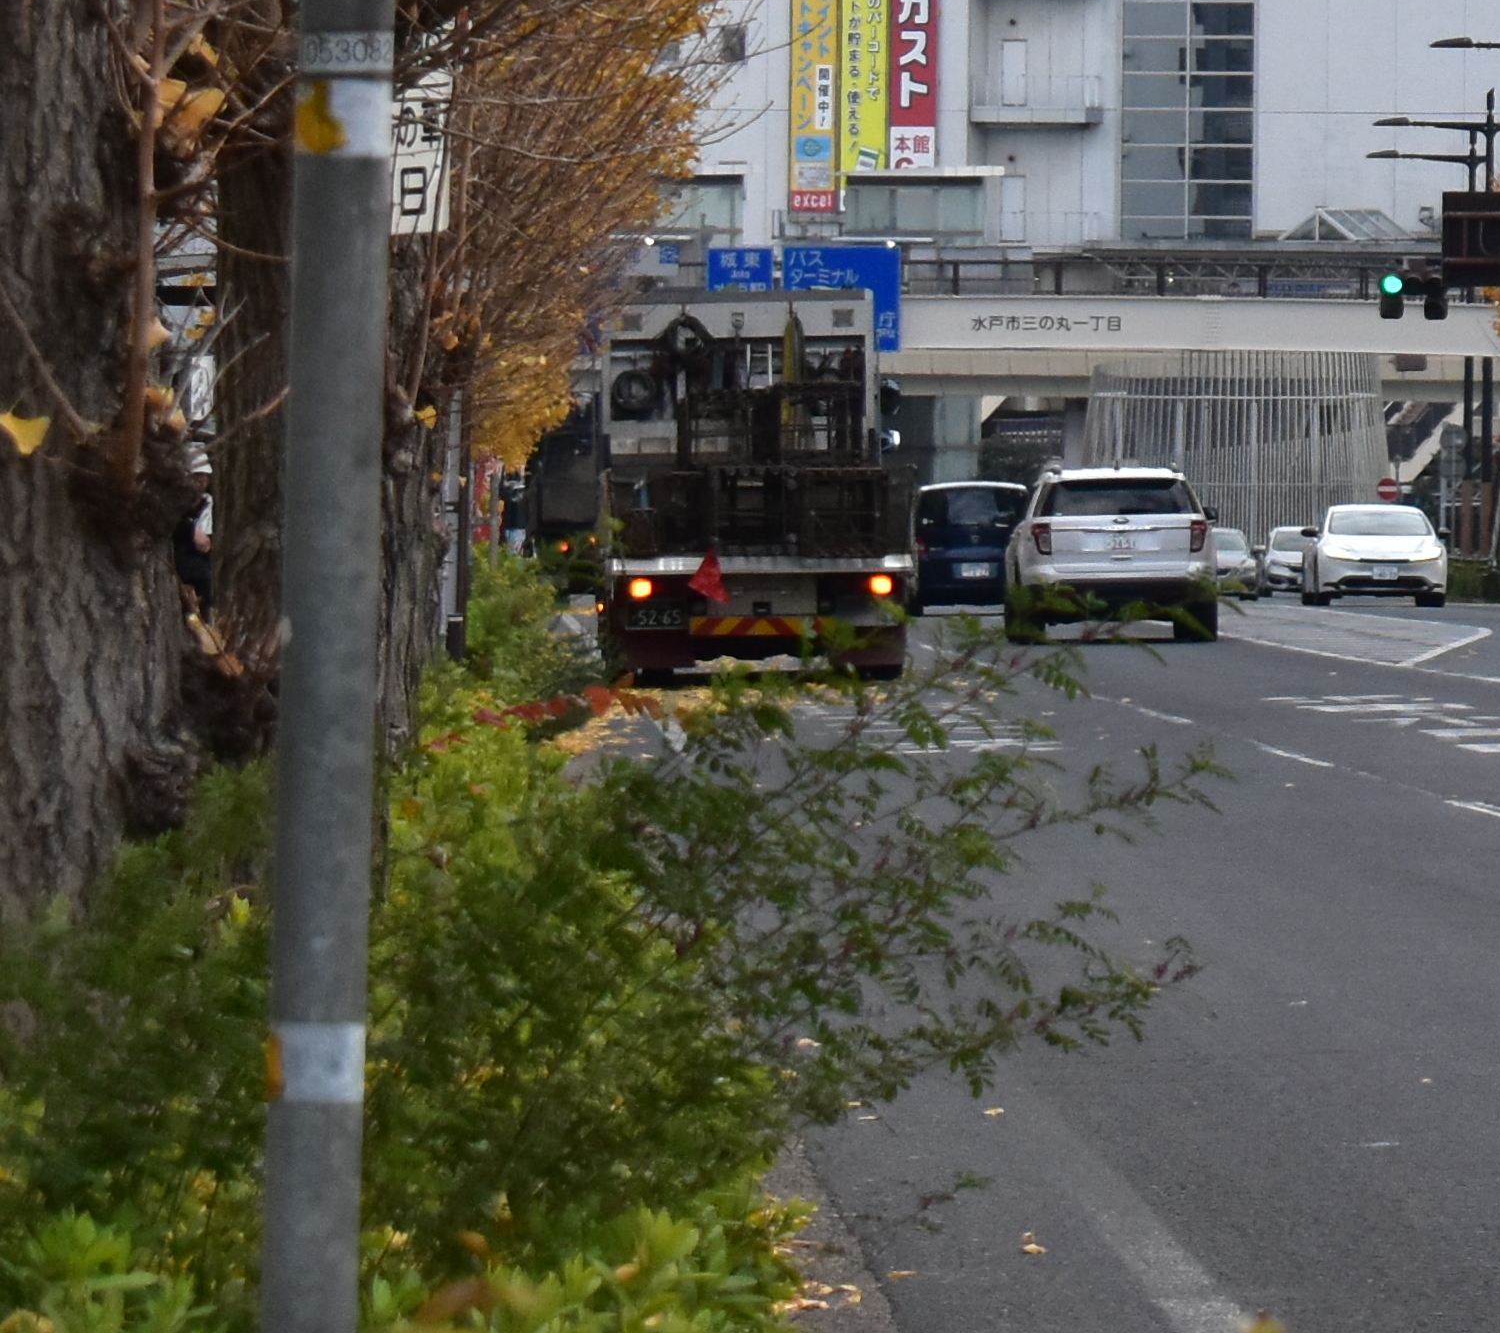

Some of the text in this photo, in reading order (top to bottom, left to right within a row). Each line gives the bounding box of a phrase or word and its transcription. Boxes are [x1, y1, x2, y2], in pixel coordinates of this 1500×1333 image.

[894, 134, 930, 154] 本館
[794, 193, 832, 208] excel
[719, 251, 761, 269] 城東
[789, 250, 824, 267] バス
[789, 268, 861, 285] ターミナル
[972, 315, 1122, 332] 水戸市三の丸一丁目
